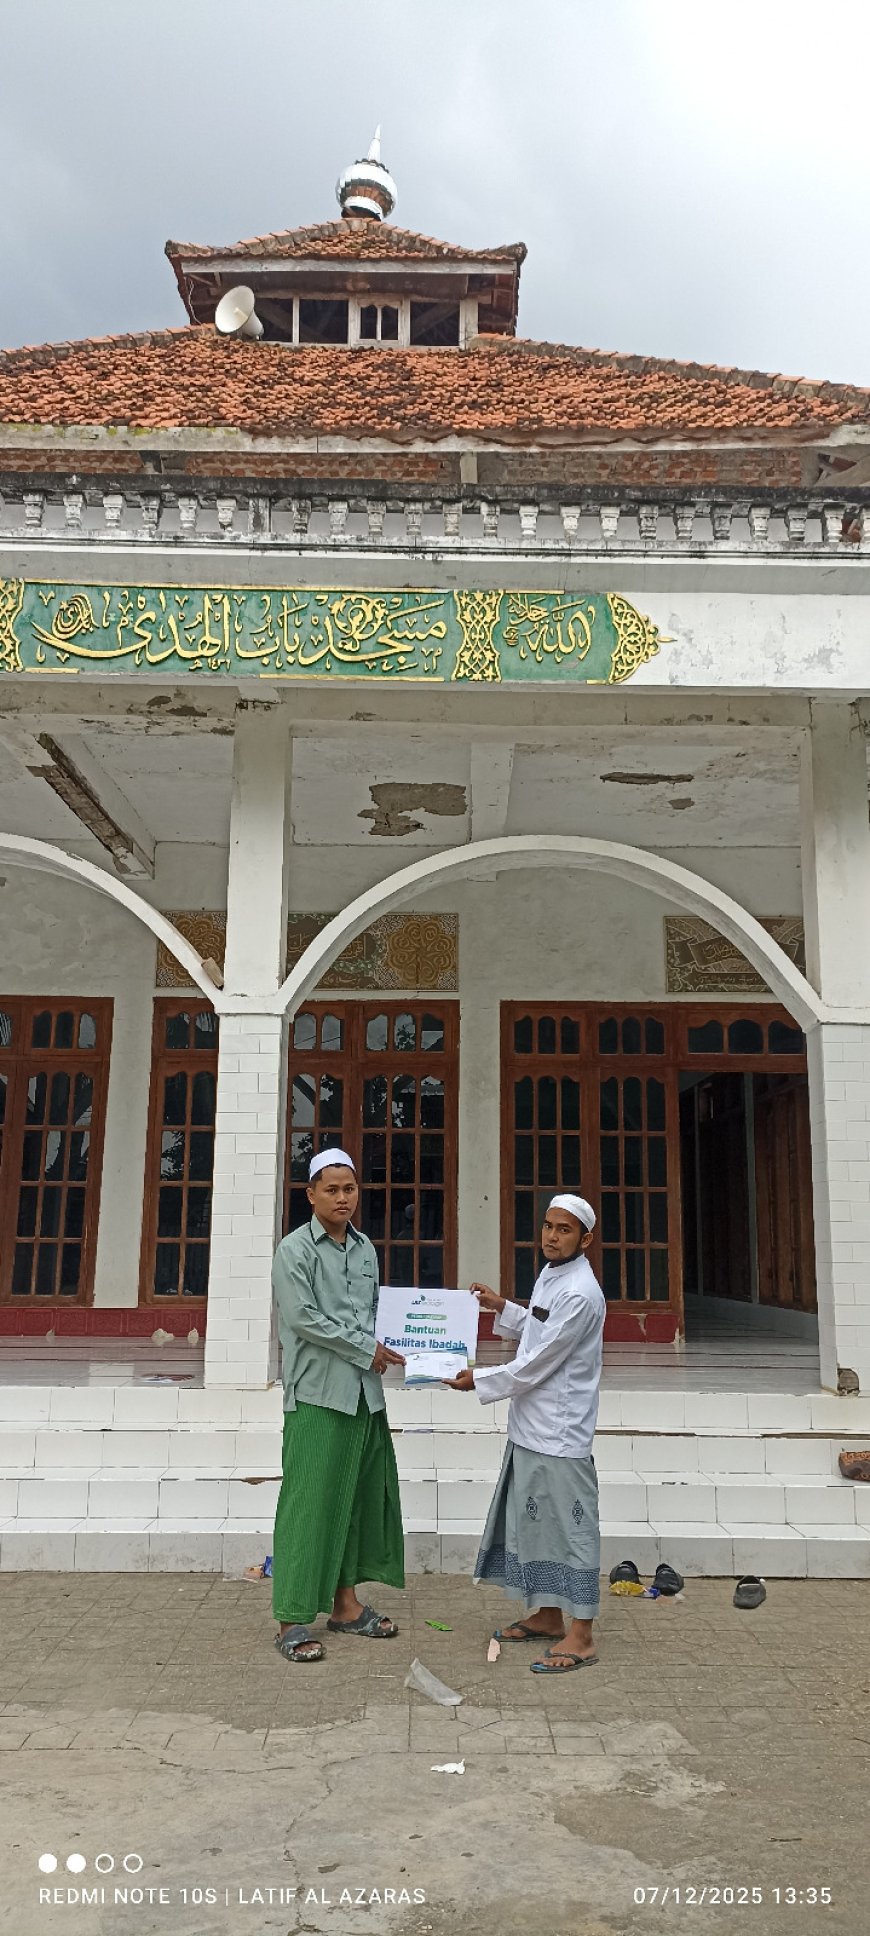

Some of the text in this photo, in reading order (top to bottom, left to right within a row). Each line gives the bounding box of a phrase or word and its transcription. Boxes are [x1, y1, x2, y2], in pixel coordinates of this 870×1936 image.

[404, 1325, 446, 1335] Bantuan
[384, 1336, 466, 1349] Fasilitas Ibadah
